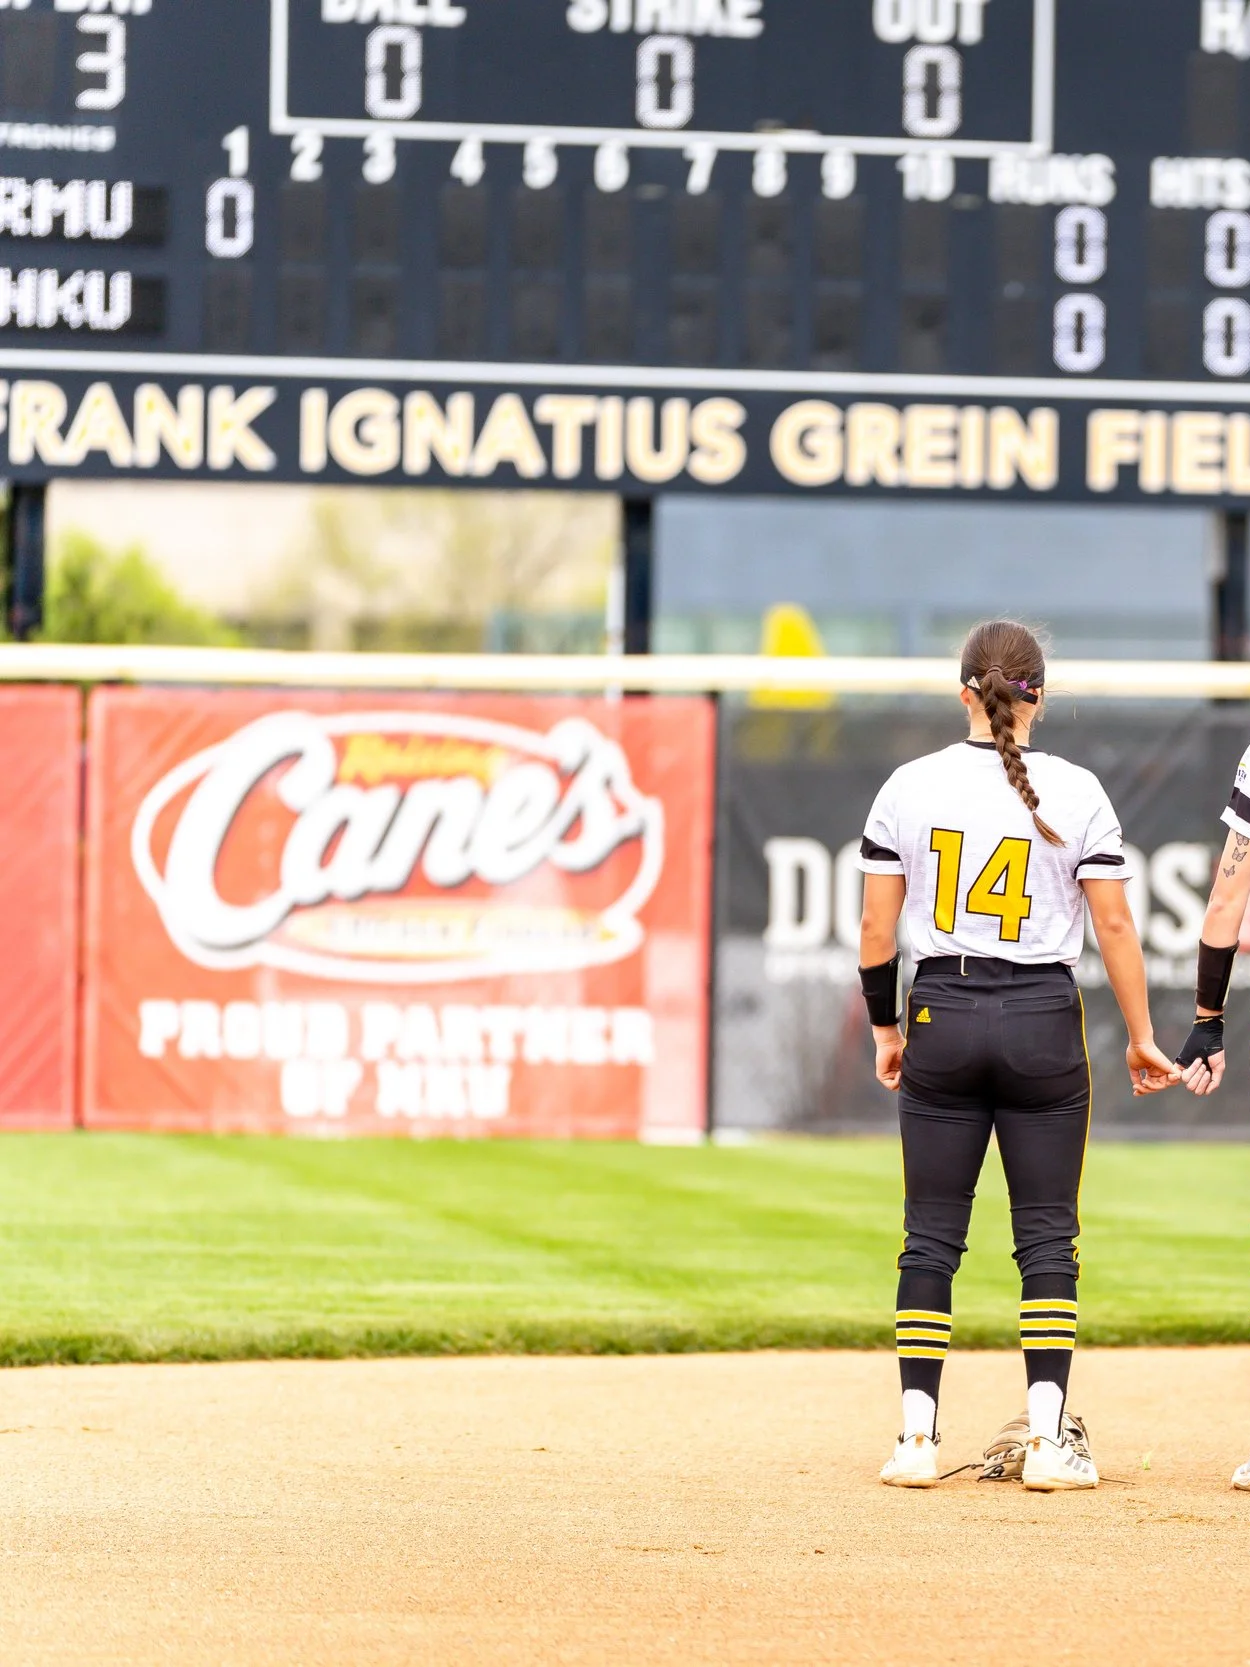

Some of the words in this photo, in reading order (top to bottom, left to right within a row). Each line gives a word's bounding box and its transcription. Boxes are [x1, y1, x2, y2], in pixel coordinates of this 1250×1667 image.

[75, 13, 126, 110] 3
[365, 24, 422, 120] 0
[635, 34, 694, 129] 0
[903, 44, 962, 138] 0
[222, 125, 249, 178] 1
[290, 131, 324, 182] 2
[362, 132, 396, 185] 3
[450, 136, 485, 186] 4
[523, 137, 558, 190] 5
[594, 140, 630, 193] 6
[683, 142, 718, 195] 7
[896, 150, 955, 202] 10
[206, 177, 253, 259] 0
[1054, 206, 1106, 284] 0
[1053, 293, 1105, 373] 0
[0, 379, 276, 472] RANK
[300, 386, 748, 486] IGNATIUS
[769, 399, 1059, 491] GREIN
[929, 827, 1032, 942] 14
